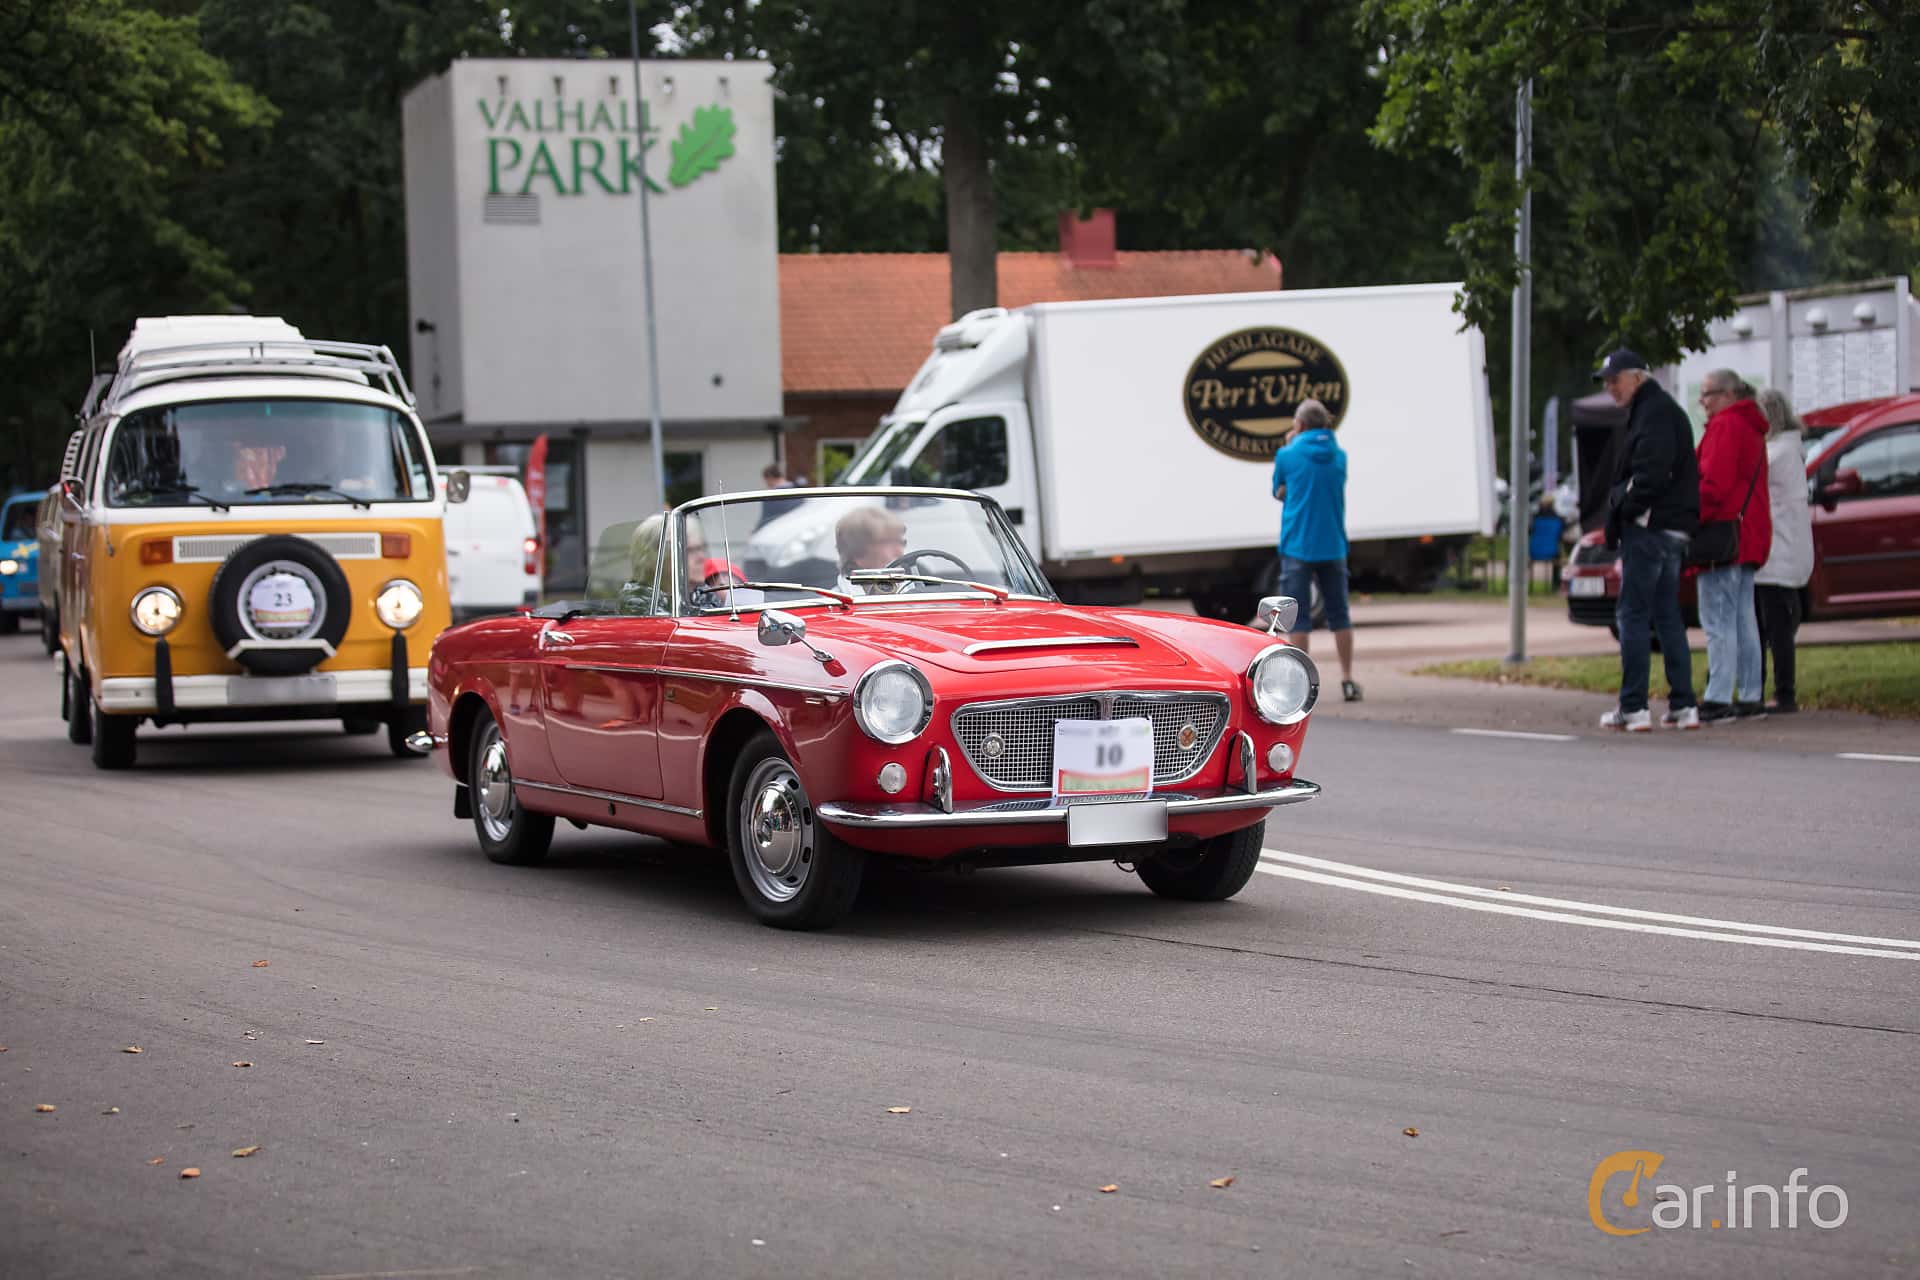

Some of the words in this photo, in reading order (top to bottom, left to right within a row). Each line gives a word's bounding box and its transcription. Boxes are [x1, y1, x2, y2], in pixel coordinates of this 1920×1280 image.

[478, 99, 660, 132] VALHALL
[486, 137, 667, 195] PARK
[273, 592, 293, 607] 23
[1095, 743, 1125, 769] 10
